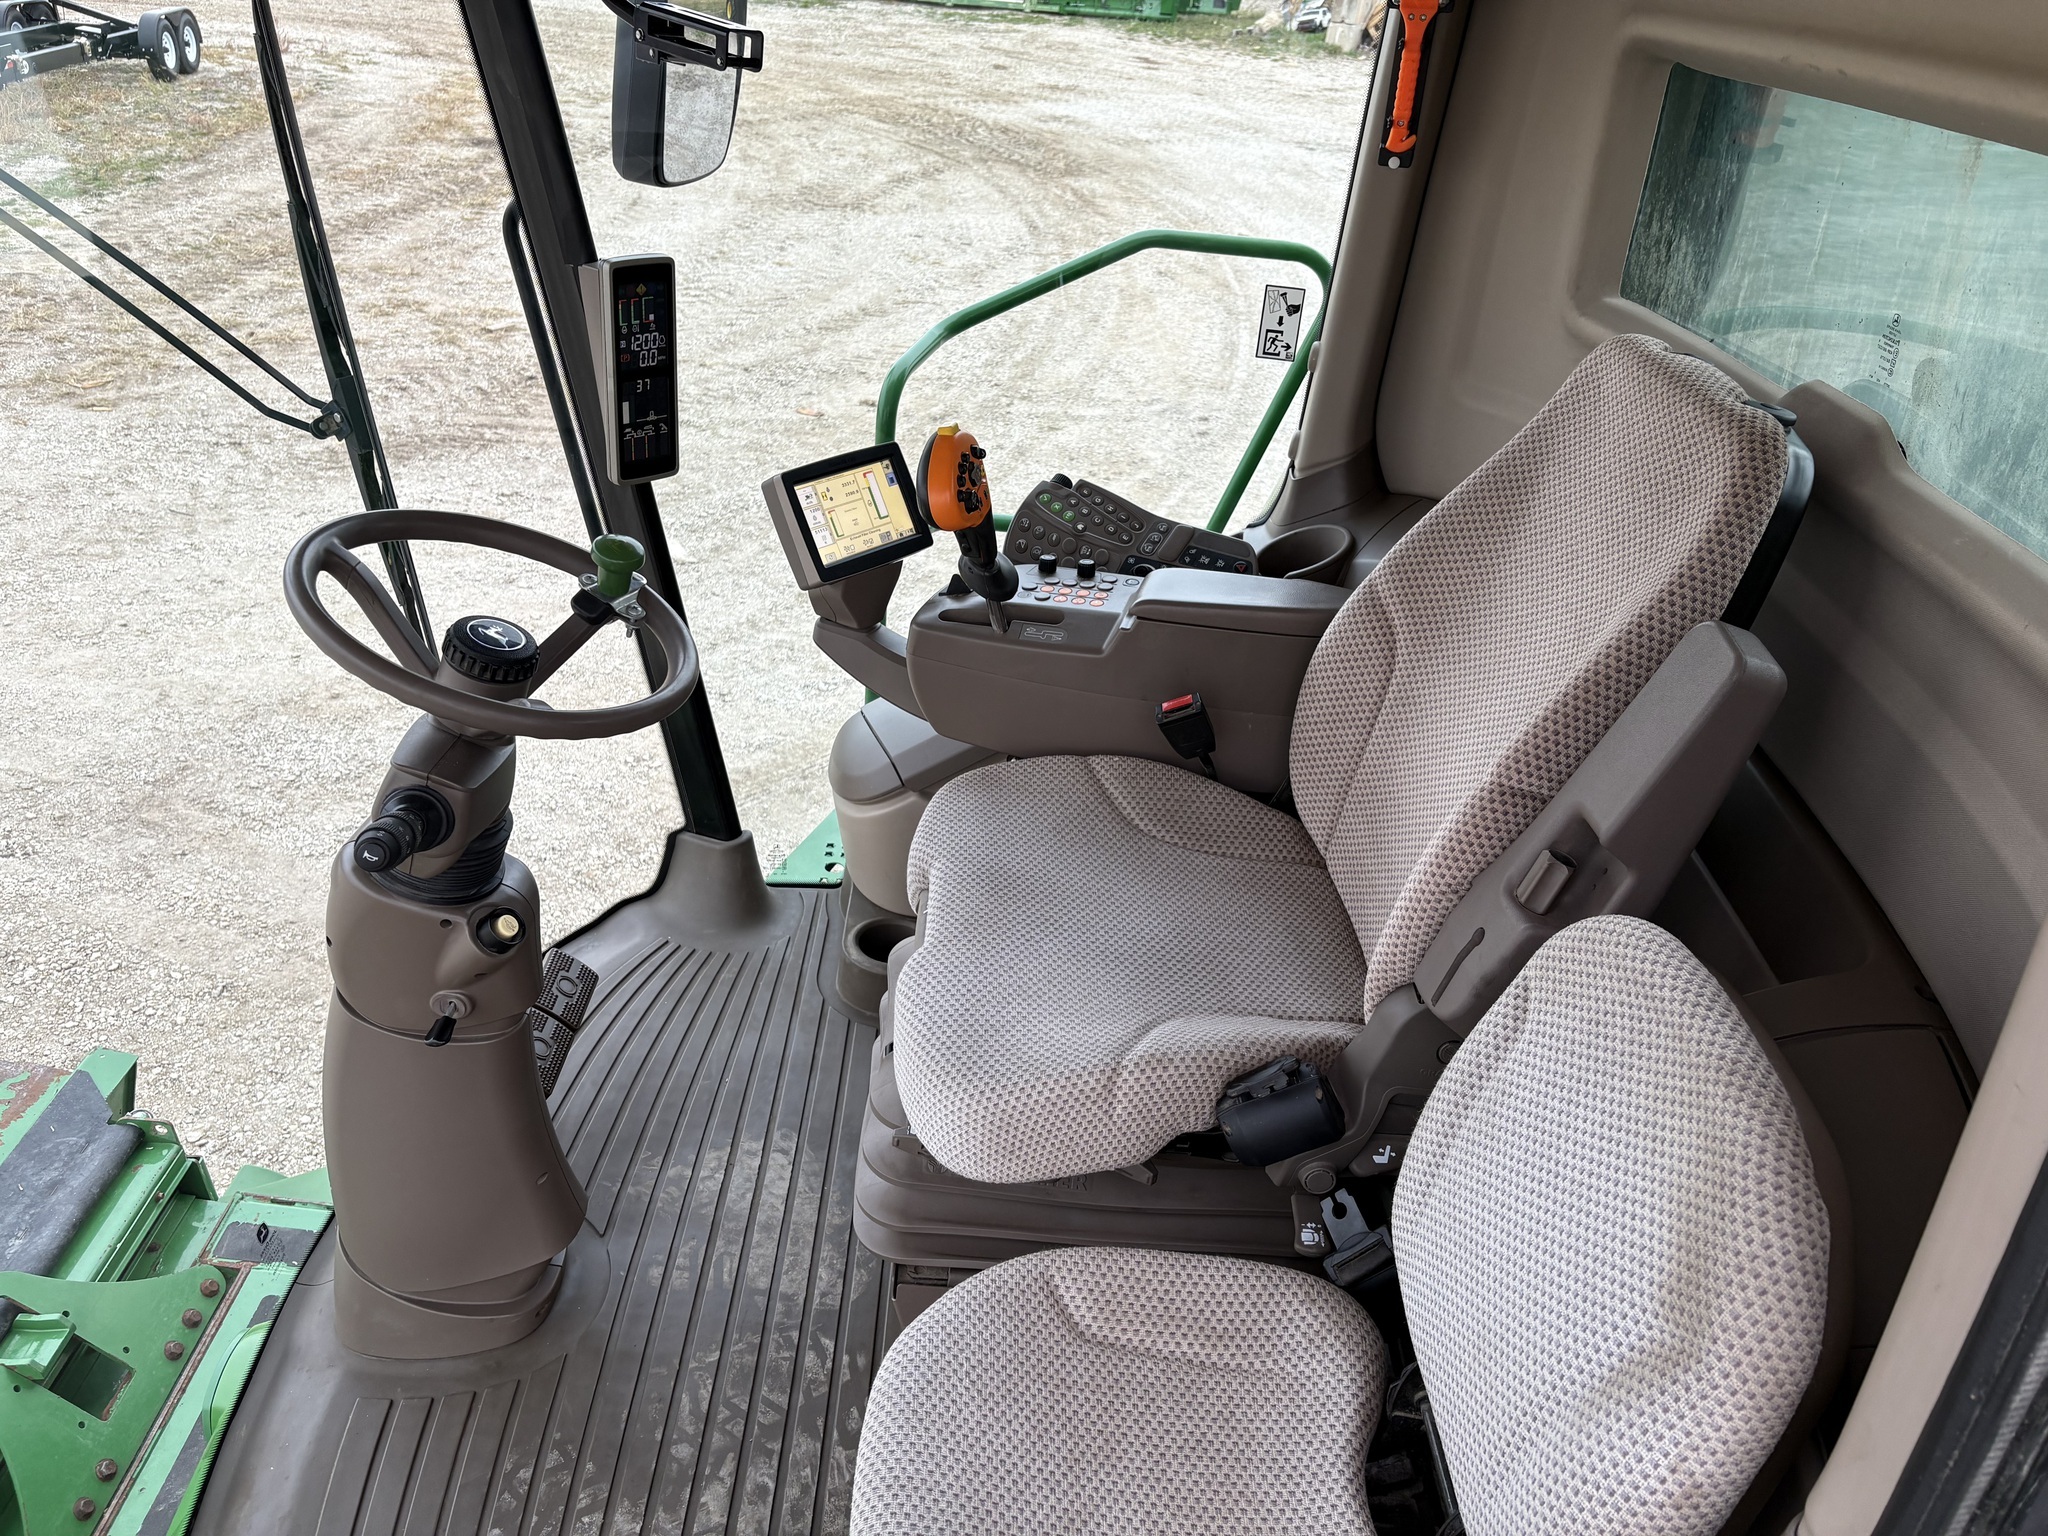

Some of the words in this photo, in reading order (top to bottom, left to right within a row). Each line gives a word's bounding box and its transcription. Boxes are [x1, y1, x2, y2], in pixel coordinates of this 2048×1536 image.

[631, 332, 659, 351] 1200
[640, 349, 658, 367] 0.0
[636, 378, 650, 392] 37
